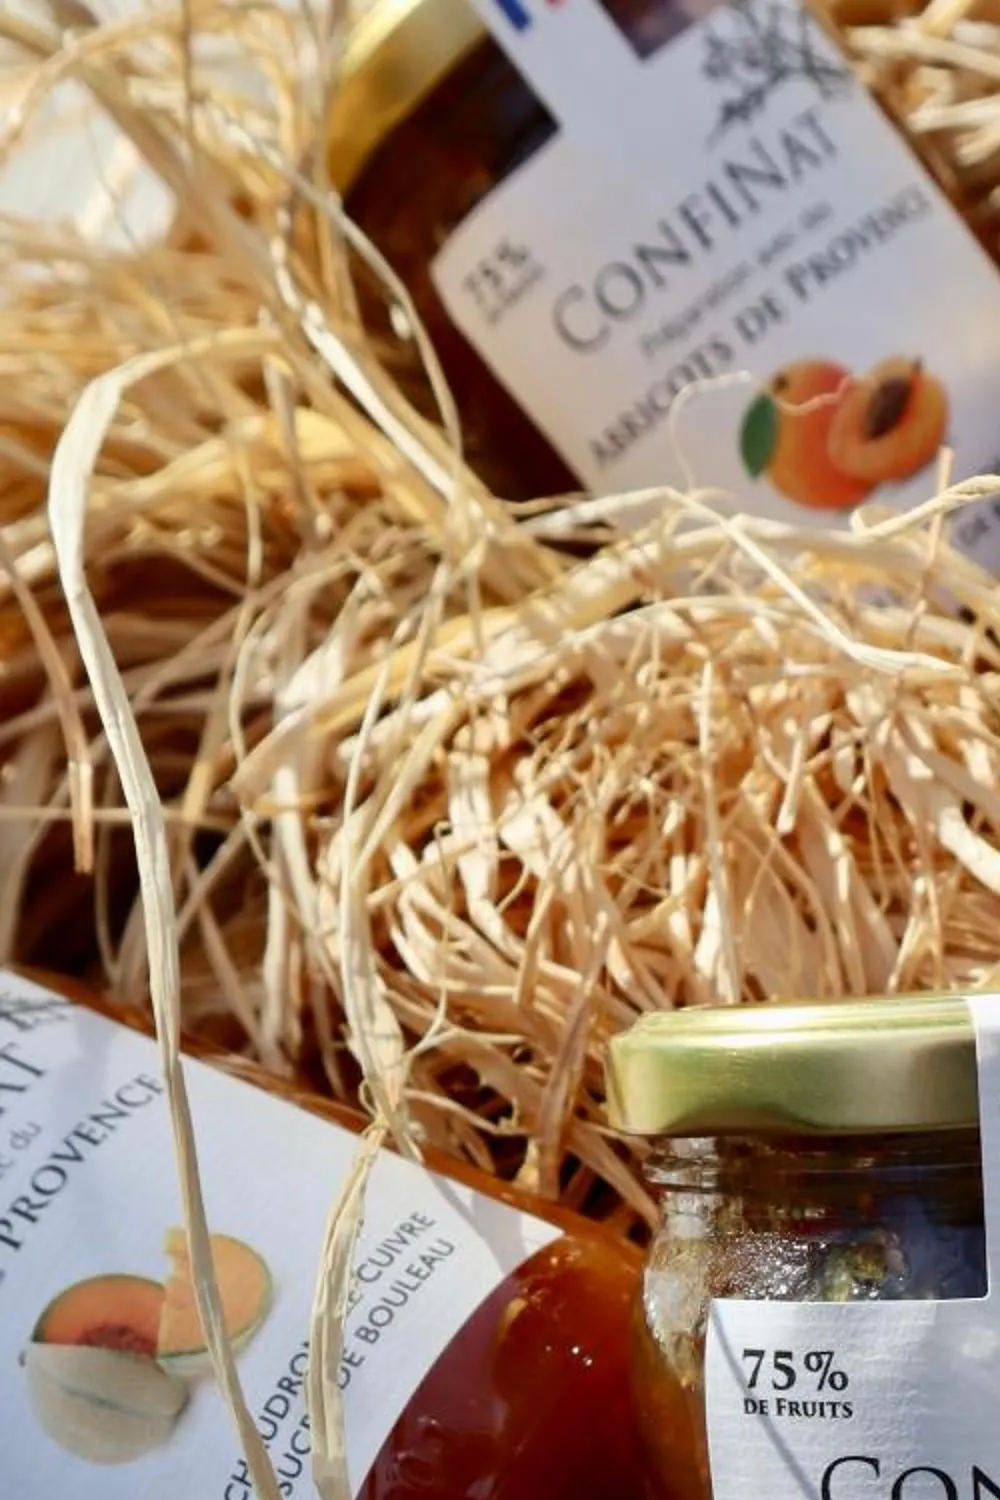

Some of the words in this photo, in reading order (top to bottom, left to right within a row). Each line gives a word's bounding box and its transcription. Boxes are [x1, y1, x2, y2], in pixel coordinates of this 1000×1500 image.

[551, 108, 839, 357] CONFINAT
[732, 289, 786, 347] DE
[356, 1210, 437, 1283] CUIVRE
[353, 1238, 456, 1346] BOULEAU
[742, 1348, 849, 1391] 75%
[743, 1397, 769, 1417] DE
[775, 1397, 854, 1419] FRUITS
